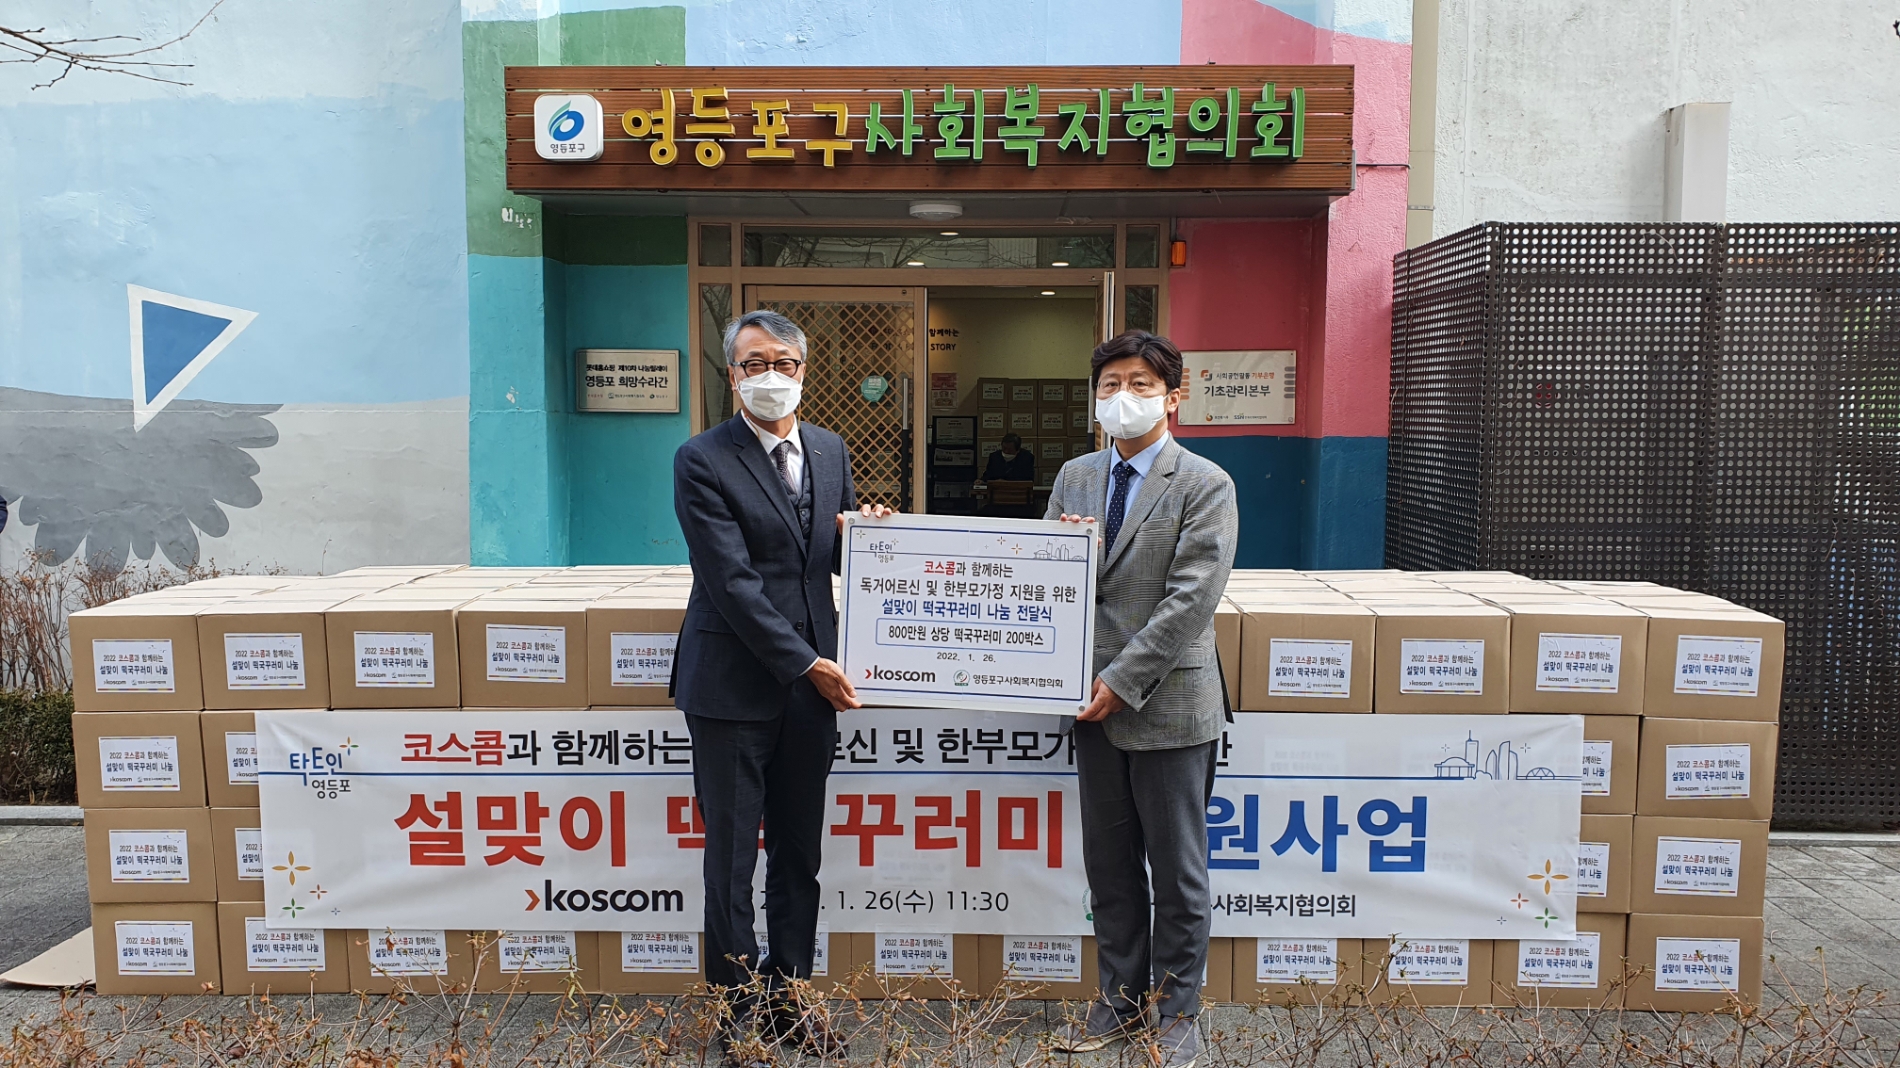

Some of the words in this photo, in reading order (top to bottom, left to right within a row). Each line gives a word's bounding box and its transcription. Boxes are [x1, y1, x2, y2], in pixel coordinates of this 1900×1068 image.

[550, 143, 585, 153] 영등포구
[930, 343, 957, 351] STORY
[585, 375, 615, 387] 영등포
[618, 376, 669, 388] 희망수라간
[1204, 385, 1271, 398] 기초관리본부
[877, 554, 895, 563] 영등포
[924, 560, 967, 577] 코스콤과
[971, 562, 1014, 579] 함께하는
[860, 576, 921, 596] 독거어르신
[926, 580, 938, 597] 및
[944, 580, 1005, 600] 한부모가정
[1010, 584, 1046, 602] 지원을
[1052, 585, 1077, 603] 위한
[882, 598, 918, 617] 설맞이
[923, 600, 982, 619] 떡국꾸러미
[987, 603, 1011, 621] 나눔
[1016, 605, 1053, 623] 전달식
[888, 625, 927, 642] 800만원
[930, 627, 951, 643] 상당
[954, 628, 1002, 645] 떡국꾸러미
[1006, 630, 1044, 646] 200박스
[379, 646, 400, 655] 코스콤과
[403, 647, 424, 655] 함께하는
[511, 641, 532, 650] 코스콤과
[534, 642, 555, 650] 함께하는
[118, 654, 139, 662] 코스콤과
[142, 654, 163, 662] 함께하는
[249, 649, 270, 657] 코스콤과
[273, 649, 294, 657] 함께하는
[491, 652, 510, 662] 설맞이
[513, 653, 544, 662] 떡국꾸러미
[547, 654, 559, 663] 나눔
[936, 652, 961, 662] 2022.
[968, 653, 976, 662] 1.
[983, 654, 997, 663] 26.
[1548, 650, 1561, 658] 2022
[1564, 650, 1586, 659] 코스콤과
[1588, 651, 1610, 660] 함께하는
[1702, 653, 1725, 662] 코스콤과
[1728, 654, 1750, 663] 함께하는
[360, 658, 378, 667] 설맞이
[382, 658, 412, 667] 떡국꾸러미
[416, 659, 428, 668] 나눔
[1295, 655, 1317, 664] 코스콤과
[1320, 656, 1341, 665] 함께하는
[1427, 654, 1449, 663] 코스콤과
[1452, 655, 1474, 663] 함께하는
[99, 665, 118, 675] 설맞이
[121, 665, 152, 674] 떡국꾸러미
[155, 665, 168, 674] 나눔
[231, 661, 250, 670] 설맞이
[252, 660, 283, 669] 떡국꾸러미
[286, 660, 298, 670] 나눔
[1542, 661, 1562, 671] 설맞이
[1565, 662, 1598, 672] 떡국꾸러미
[1601, 663, 1614, 673] 나눔
[1681, 664, 1701, 674] 설맞이
[1704, 665, 1737, 675] 떡국꾸러미
[1740, 667, 1753, 676] 나눔
[874, 665, 936, 683] koscom
[1274, 666, 1294, 677] 설맞이
[1297, 667, 1329, 677] 떡국꾸러미
[1332, 668, 1345, 678] 나눔
[1406, 666, 1425, 676] 설맞이
[1428, 666, 1461, 676] 떡국꾸러미
[1465, 667, 1477, 676] 나눔
[973, 674, 1064, 689] 영등포구사회복지협의회
[401, 729, 542, 767] 코스콤과
[552, 728, 692, 766] 함께하는
[892, 727, 925, 765] 및
[937, 726, 1076, 766] 한부모가
[124, 751, 145, 759] 코스콤과
[147, 751, 168, 759] 함께하는
[106, 762, 124, 772] 설맞이
[127, 762, 158, 771] 떡국꾸러미
[161, 762, 173, 771] 나눔
[1676, 760, 1689, 768] 2022
[1692, 759, 1715, 768] 코스콤과
[1718, 759, 1740, 767] 함께하는
[1672, 771, 1691, 781] 설맞이
[1695, 771, 1728, 780] 떡국꾸러미
[1731, 771, 1744, 780] 나눔
[311, 779, 352, 800] 영등포
[394, 790, 627, 867] 설맞이
[134, 844, 154, 852] 코스콤과
[157, 844, 178, 852] 함께하는
[115, 856, 134, 865] 설맞이
[136, 855, 167, 864] 떡국꾸러미
[170, 856, 182, 864] 나눔
[1682, 854, 1705, 863] 코스콤과
[1708, 855, 1730, 864] 함께하는
[1661, 864, 1681, 875] 설맞이
[1684, 865, 1717, 876] 떡국꾸러미
[1720, 867, 1733, 877] 나눔
[544, 879, 684, 913] koscom
[838, 890, 854, 910] 1.
[864, 888, 934, 914] 26(수)
[946, 890, 1010, 912] 11:30
